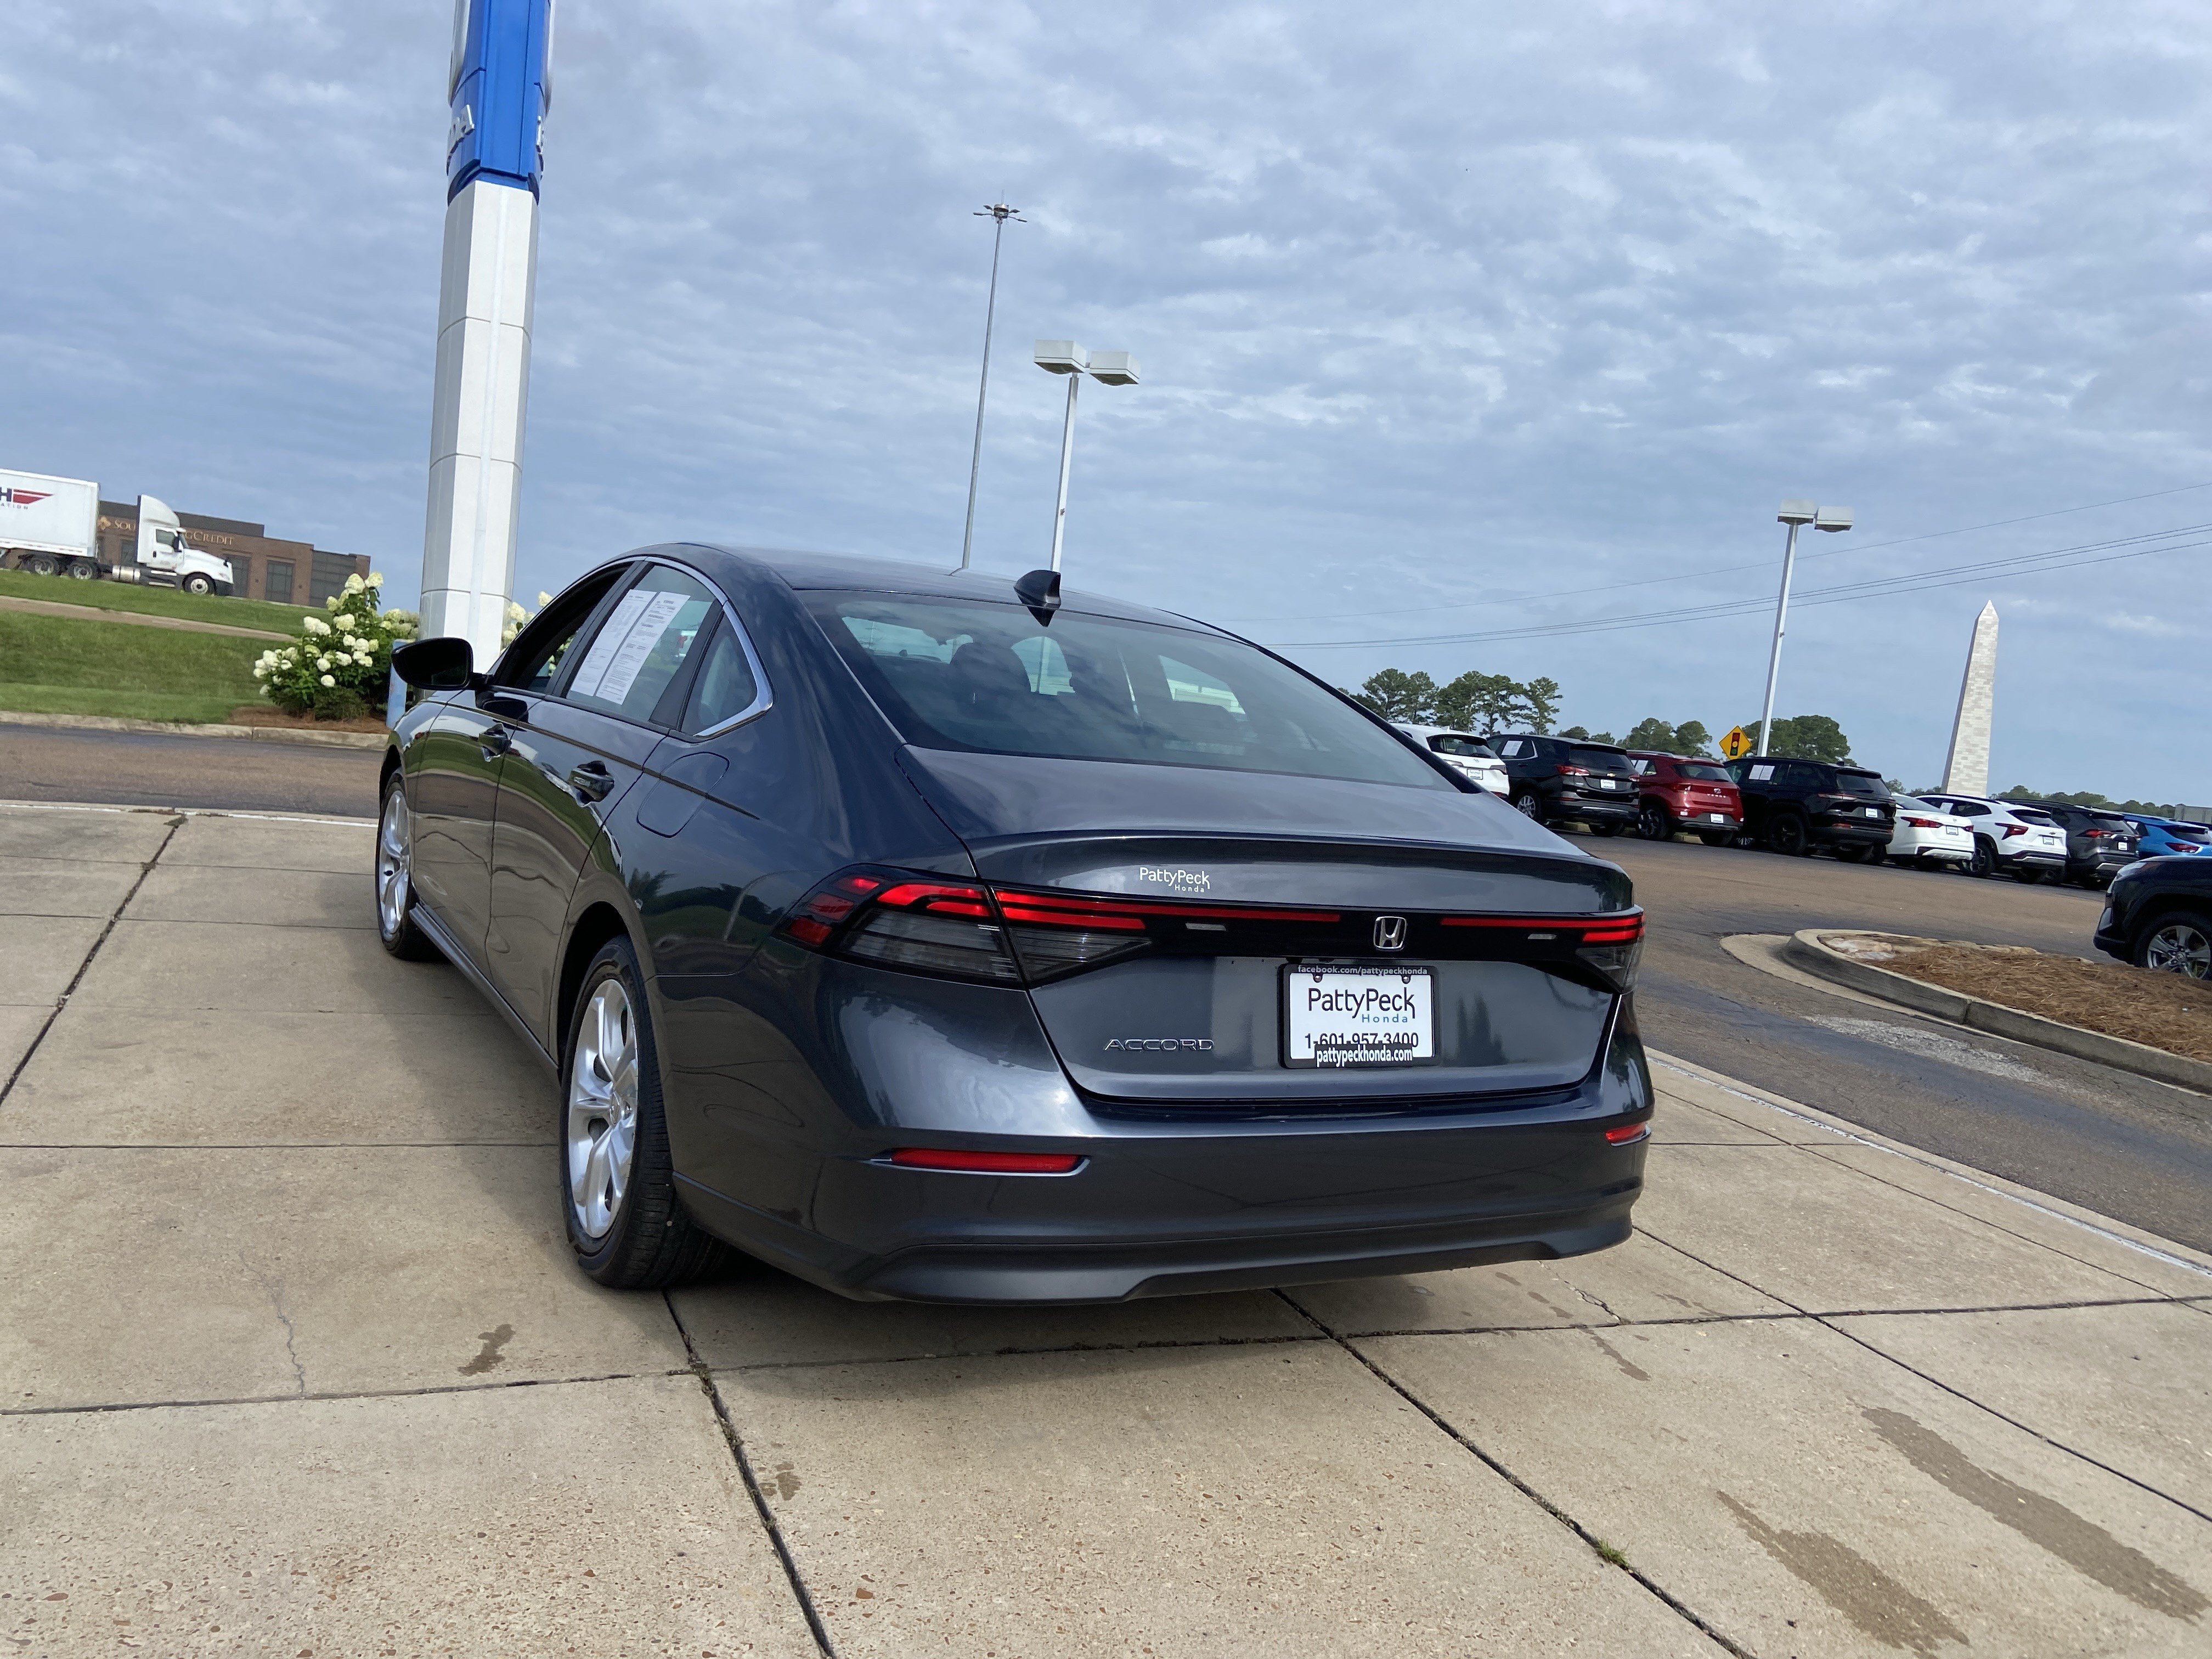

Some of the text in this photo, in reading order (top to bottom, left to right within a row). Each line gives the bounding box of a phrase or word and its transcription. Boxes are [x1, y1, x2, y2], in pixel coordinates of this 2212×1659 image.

[115, 519, 137, 532] SOU
[1139, 866, 1210, 889] PattyPeck
[1175, 884, 1205, 893] Honda
[1297, 965, 1427, 976] facebook.com/pattypeckhonda
[1308, 987, 1415, 1019] PattyPeck
[1362, 1013, 1408, 1023] Honda
[1104, 1039, 1215, 1051] ACCORD
[1304, 1032, 1419, 1049] 1-601-957-3400
[1316, 1045, 1413, 1068] pattypeckhonda.com
